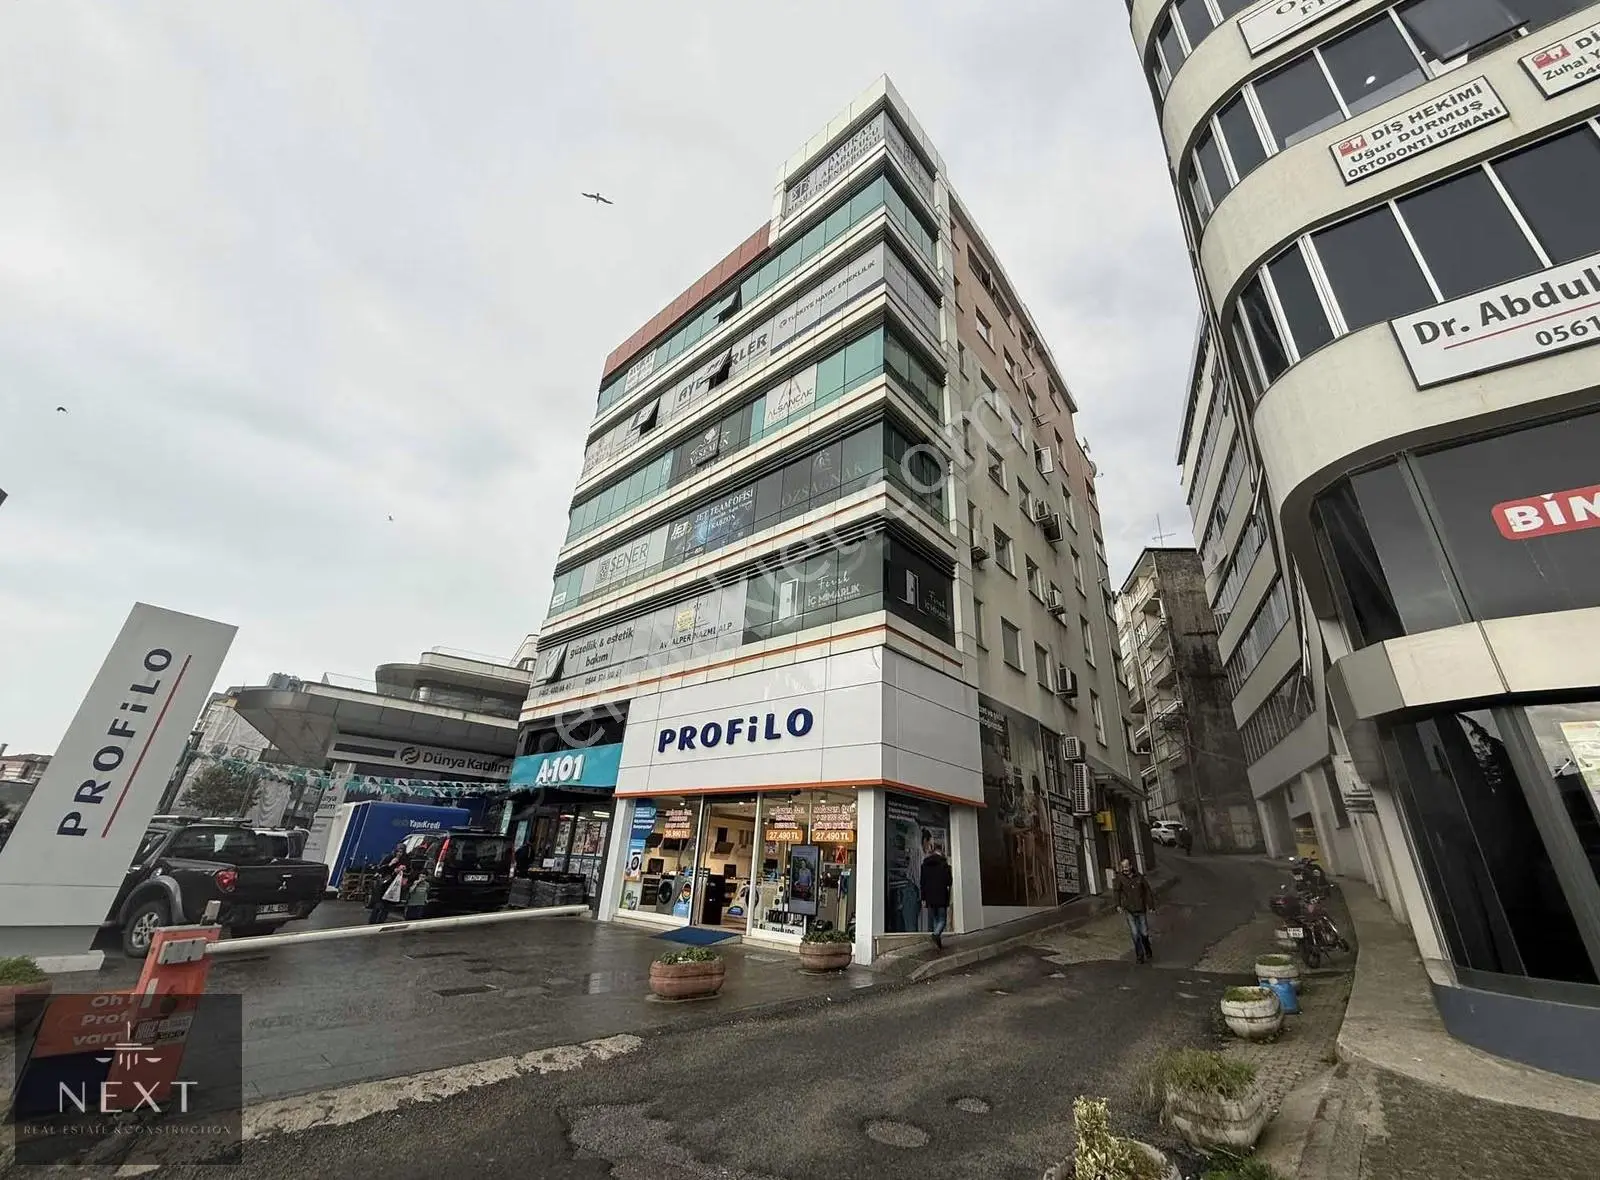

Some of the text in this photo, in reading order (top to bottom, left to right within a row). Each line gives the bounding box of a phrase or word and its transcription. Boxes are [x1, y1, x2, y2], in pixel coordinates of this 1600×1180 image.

[1575, 30, 1600, 49] Dİ
[1542, 49, 1600, 81] Zuhal Y
[1371, 82, 1484, 142] DİŞ HEKİMİ
[1348, 106, 1502, 178] ORTODONTİ UZMANI
[1350, 99, 1484, 163] Uğur DURMUŞ
[1413, 265, 1600, 345] Dr. Abdul
[569, 639, 598, 660] güzellik
[606, 627, 635, 645] estetik
[585, 653, 609, 667] bakım
[423, 751, 510, 774] Dünya Katılım
